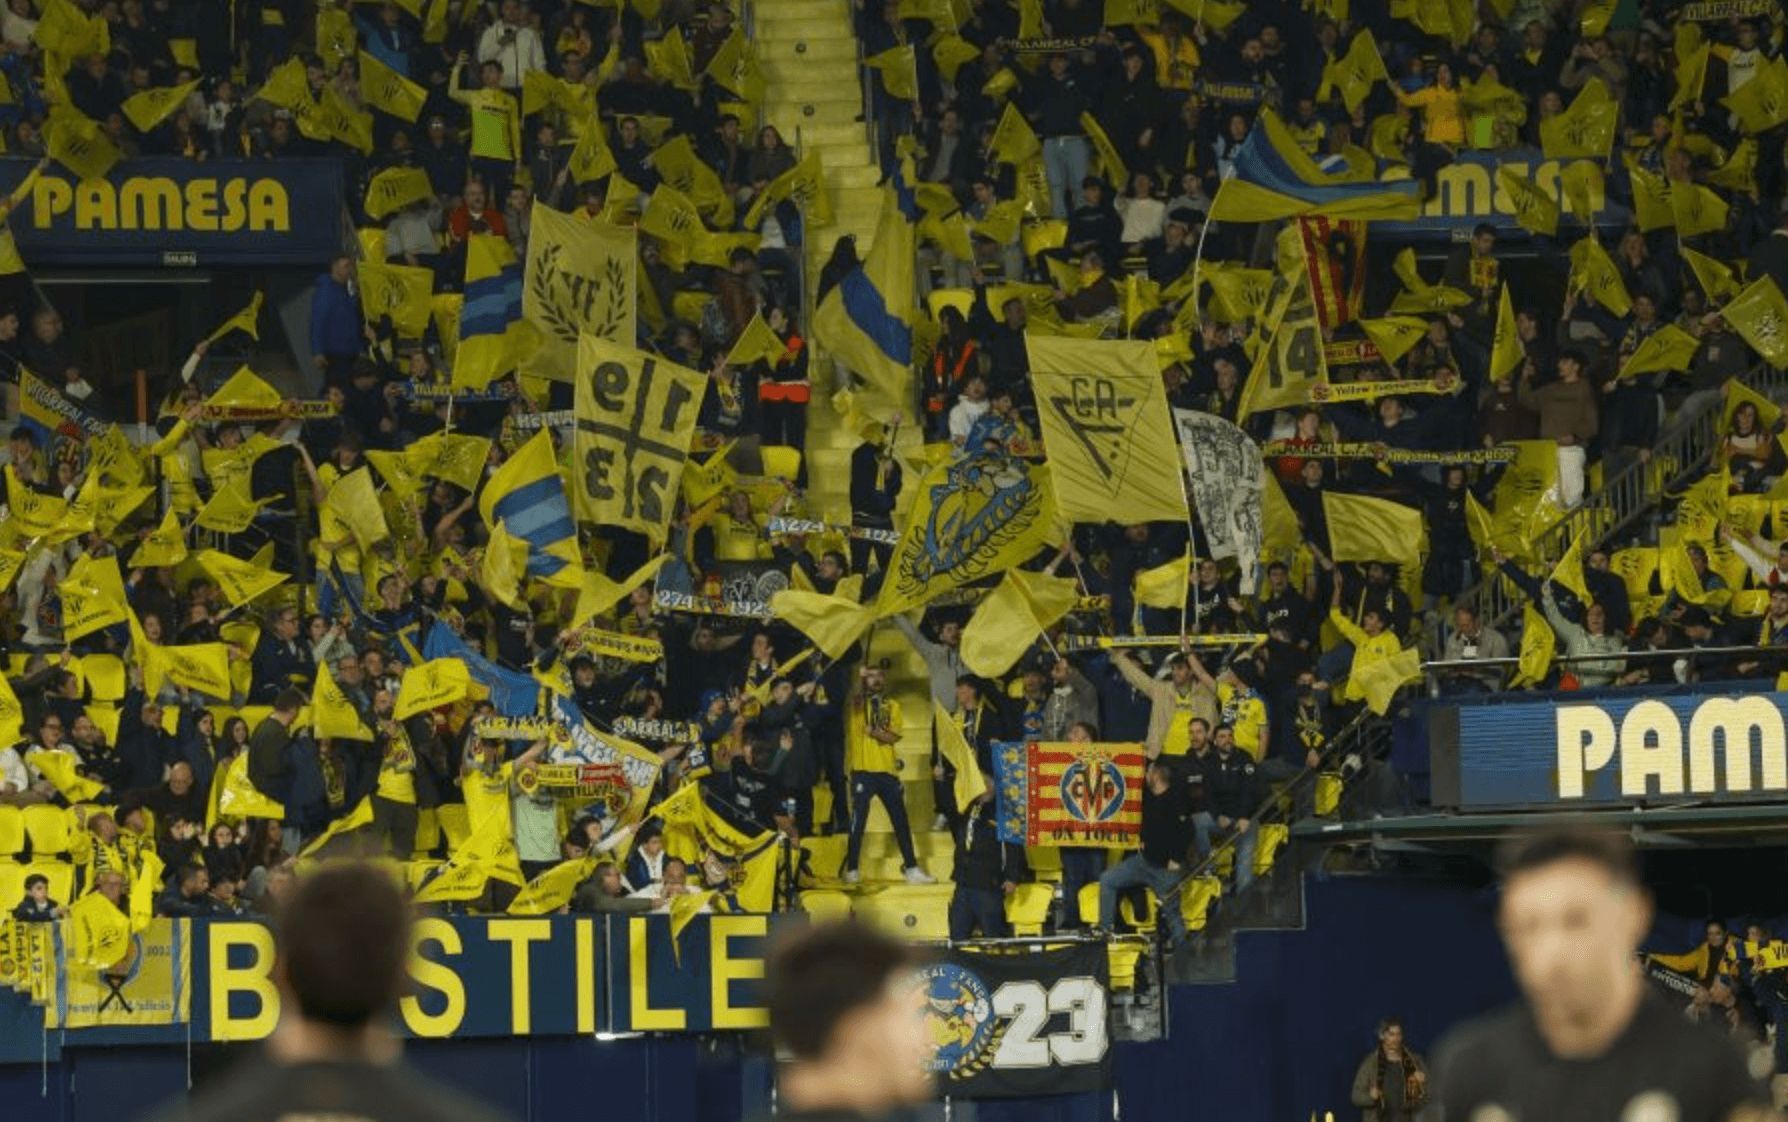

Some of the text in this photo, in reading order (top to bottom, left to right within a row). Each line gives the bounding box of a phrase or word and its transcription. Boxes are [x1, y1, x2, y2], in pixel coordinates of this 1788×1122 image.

[34, 176, 290, 231] PAMESA
[1335, 385, 1369, 396] Yellow
[1052, 826, 1130, 843] ON TOUR
[209, 917, 771, 1041] BSTILE
[990, 976, 1109, 1069] 23
